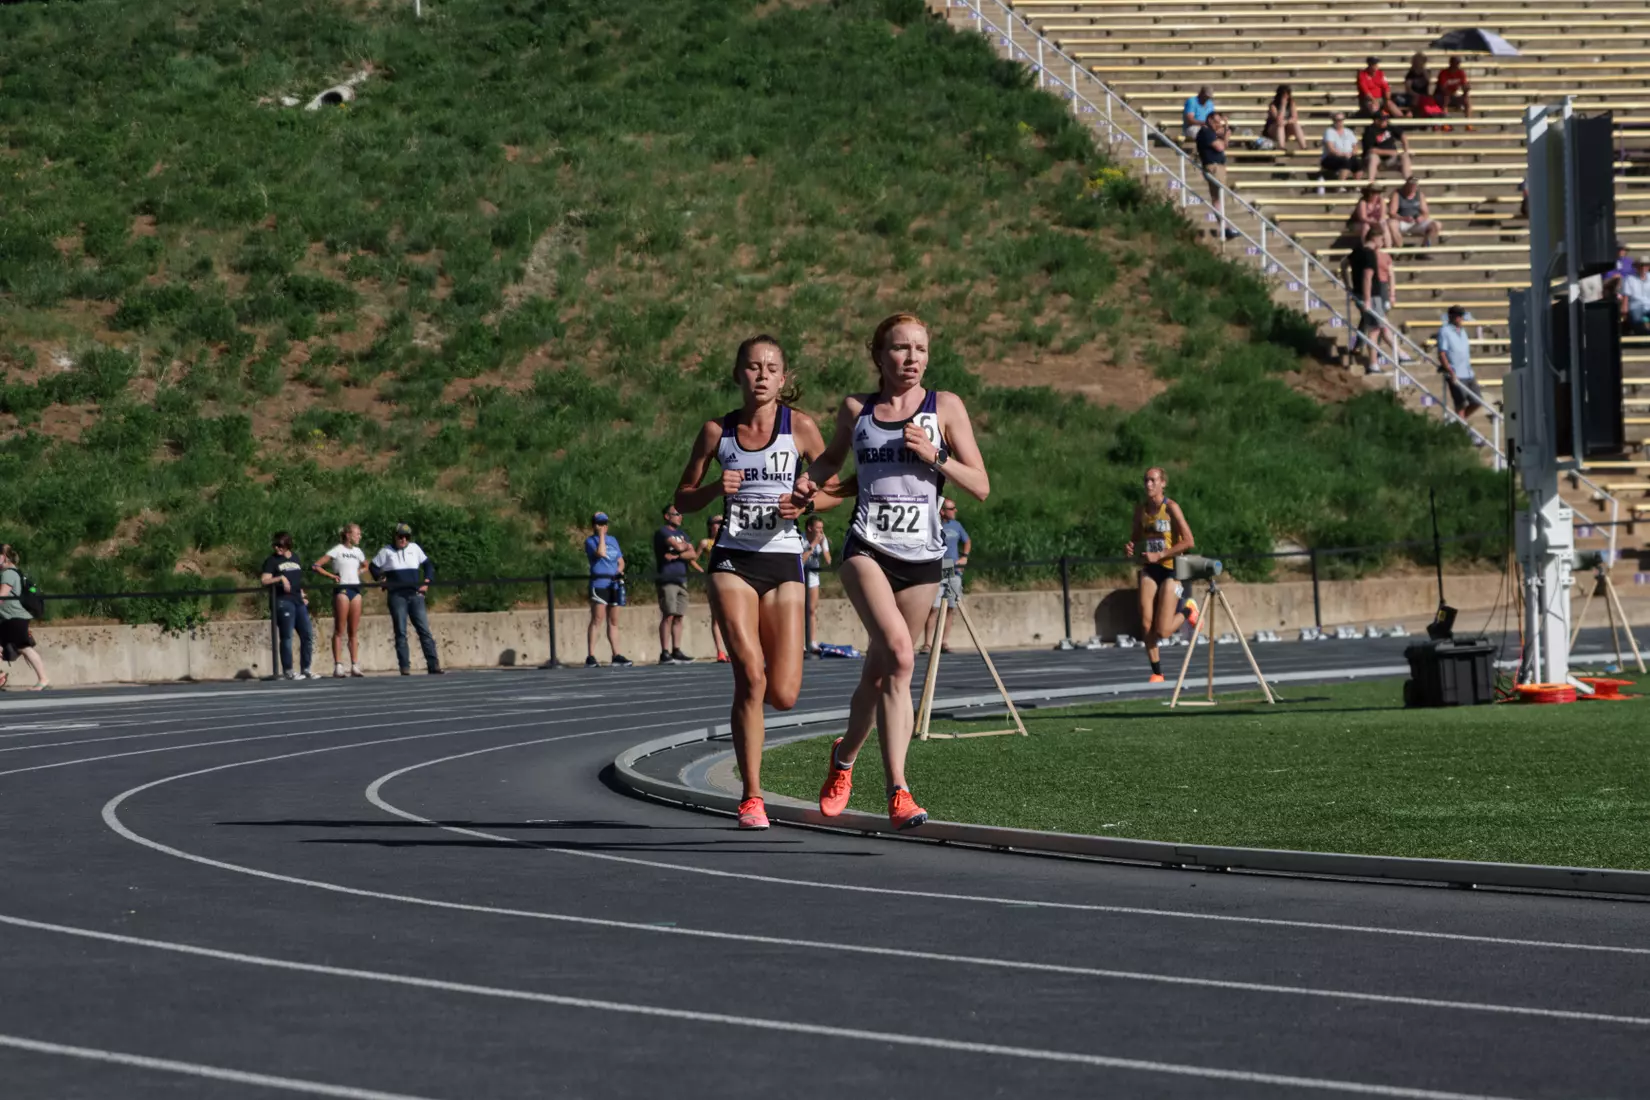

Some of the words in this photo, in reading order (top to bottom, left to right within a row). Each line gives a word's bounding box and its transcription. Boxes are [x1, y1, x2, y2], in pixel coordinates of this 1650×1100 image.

[770, 451, 789, 472] 17
[739, 505, 778, 530] 533
[876, 505, 920, 533] 522
